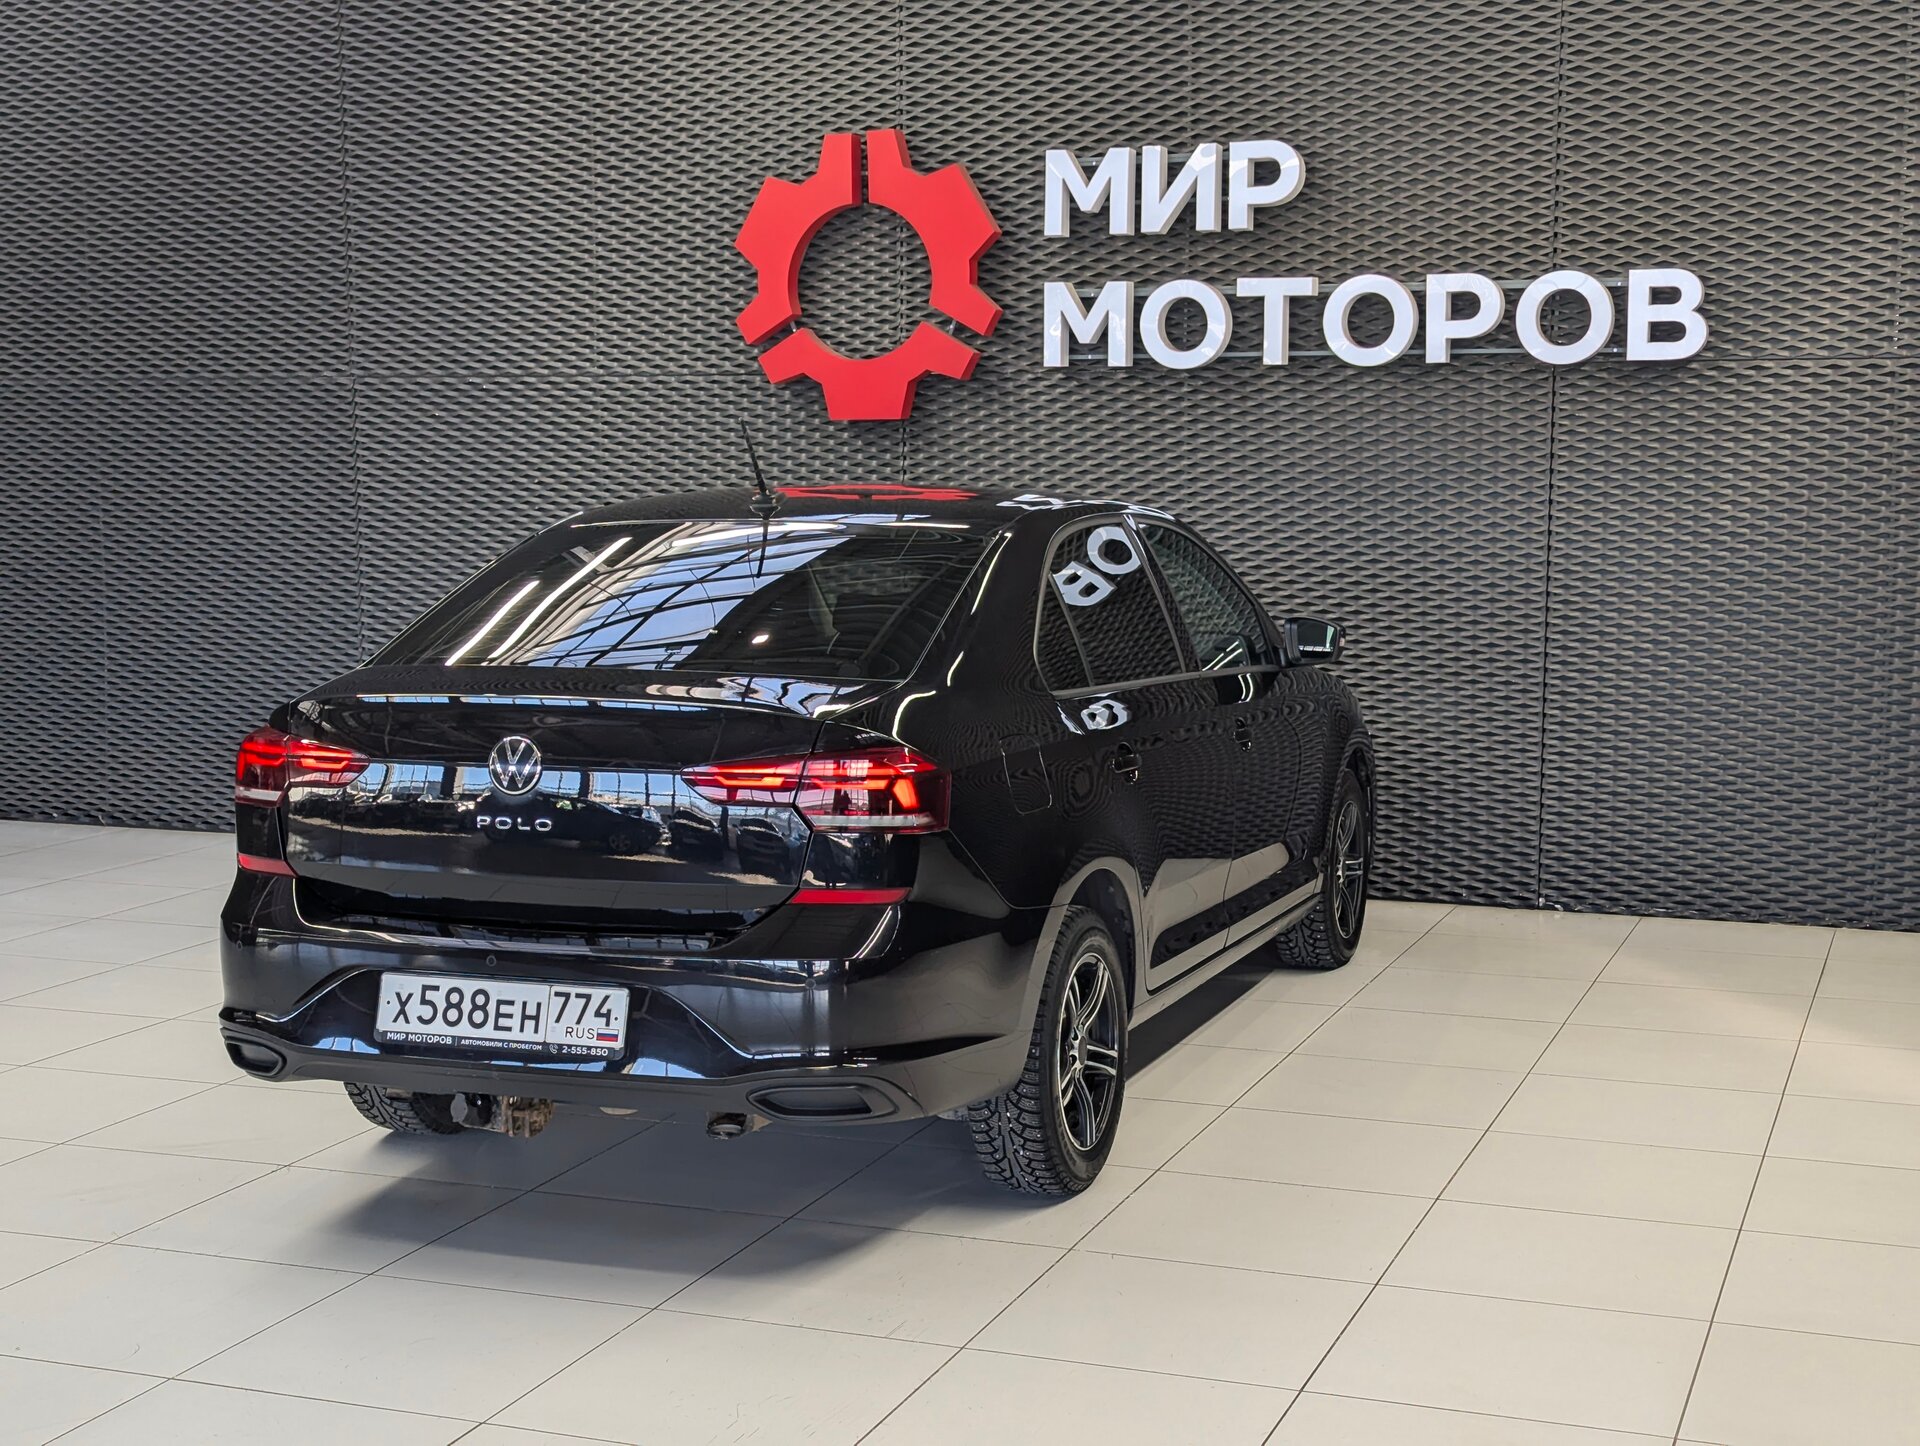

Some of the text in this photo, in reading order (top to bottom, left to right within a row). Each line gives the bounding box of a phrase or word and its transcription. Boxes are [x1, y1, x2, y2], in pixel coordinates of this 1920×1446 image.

[1044, 139, 1305, 236] МИР
[1043, 268, 1709, 369] МОТОРОВ
[476, 815, 552, 831] POLO
[553, 991, 612, 1027] 774
[386, 1032, 406, 1040] МИР
[408, 1034, 452, 1044] МОТОРОВ
[460, 1039, 502, 1047] АВТОМОБИЛИ
[561, 1046, 608, 1056] 2-555-850
[564, 1026, 595, 1040] RUS
